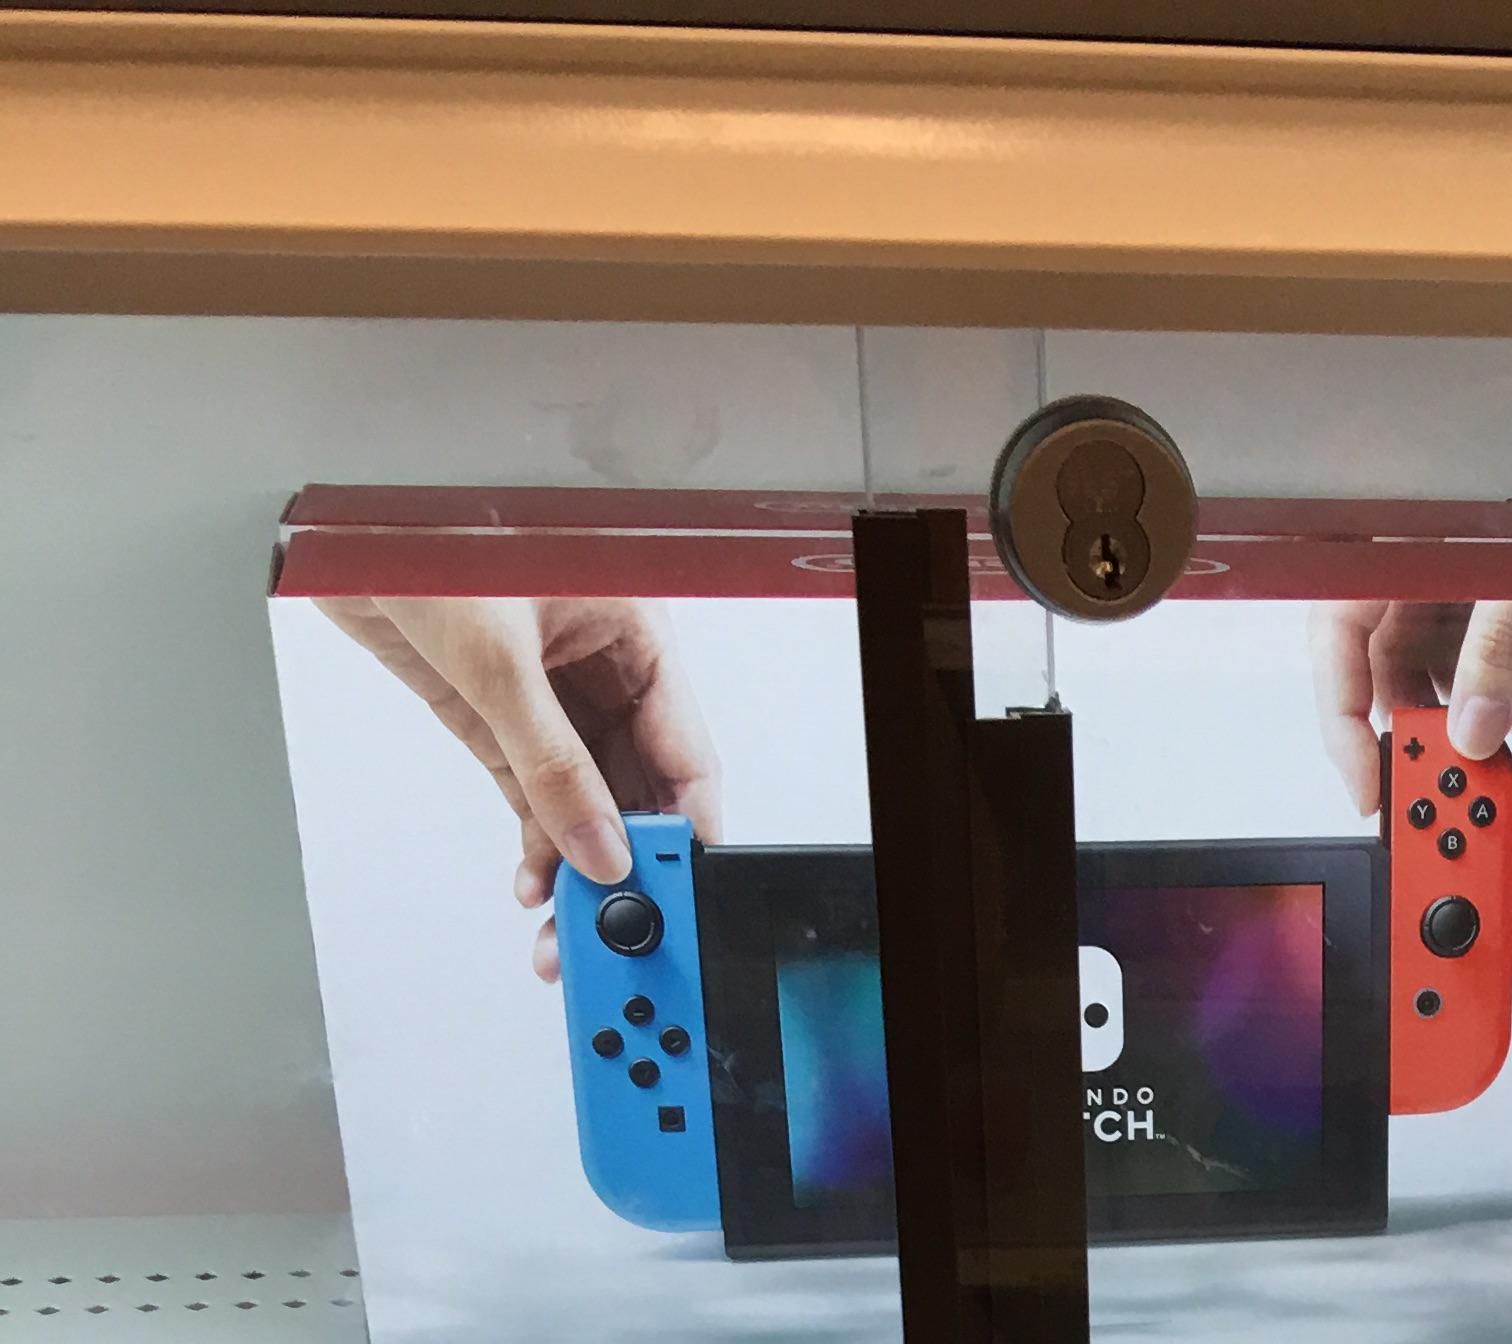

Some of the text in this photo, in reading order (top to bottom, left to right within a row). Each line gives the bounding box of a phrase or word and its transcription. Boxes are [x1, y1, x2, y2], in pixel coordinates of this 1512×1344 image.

[1448, 773, 1459, 788] X
[1417, 805, 1428, 820] Y
[1476, 804, 1489, 818] A
[1448, 835, 1458, 850] B
